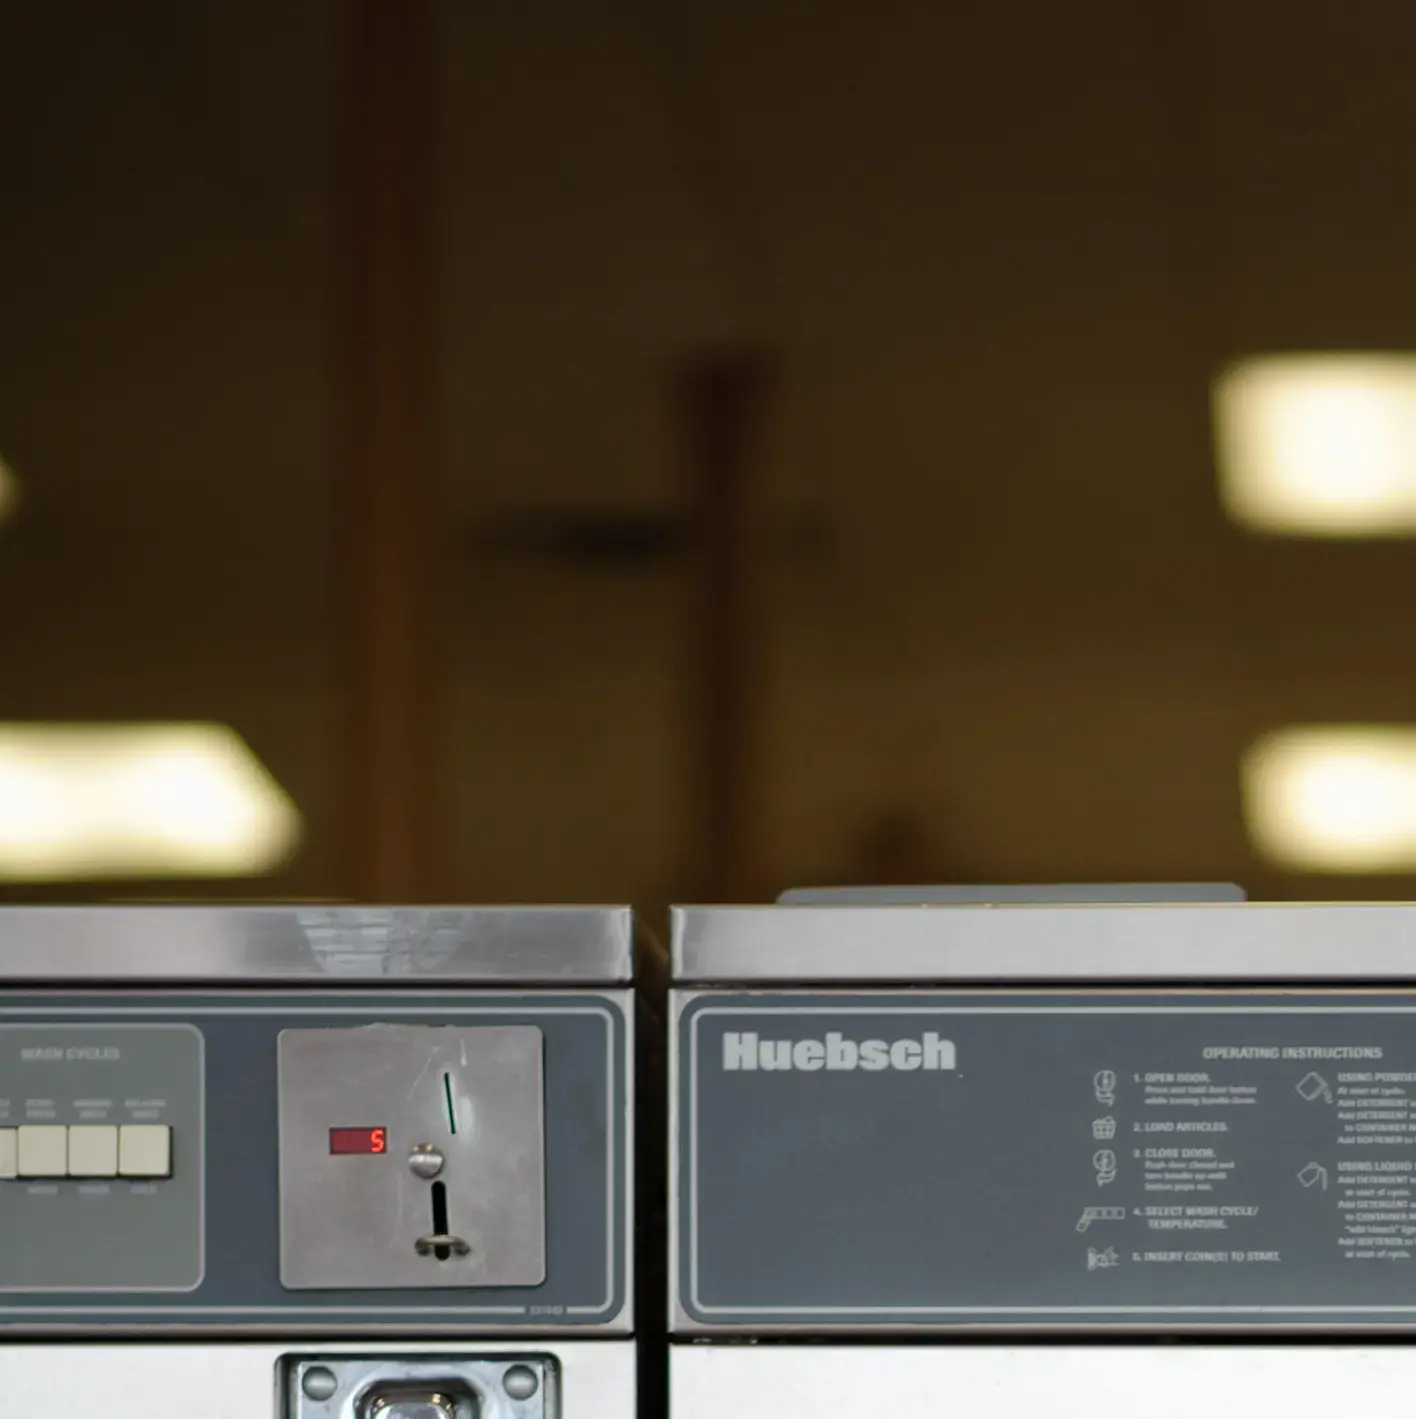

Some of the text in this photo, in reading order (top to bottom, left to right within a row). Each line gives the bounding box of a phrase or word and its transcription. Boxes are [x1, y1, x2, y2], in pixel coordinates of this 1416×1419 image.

[722, 1032, 956, 1071] Huebsch
[1203, 1046, 1382, 1059] OPERATING INSTRUCTIONS
